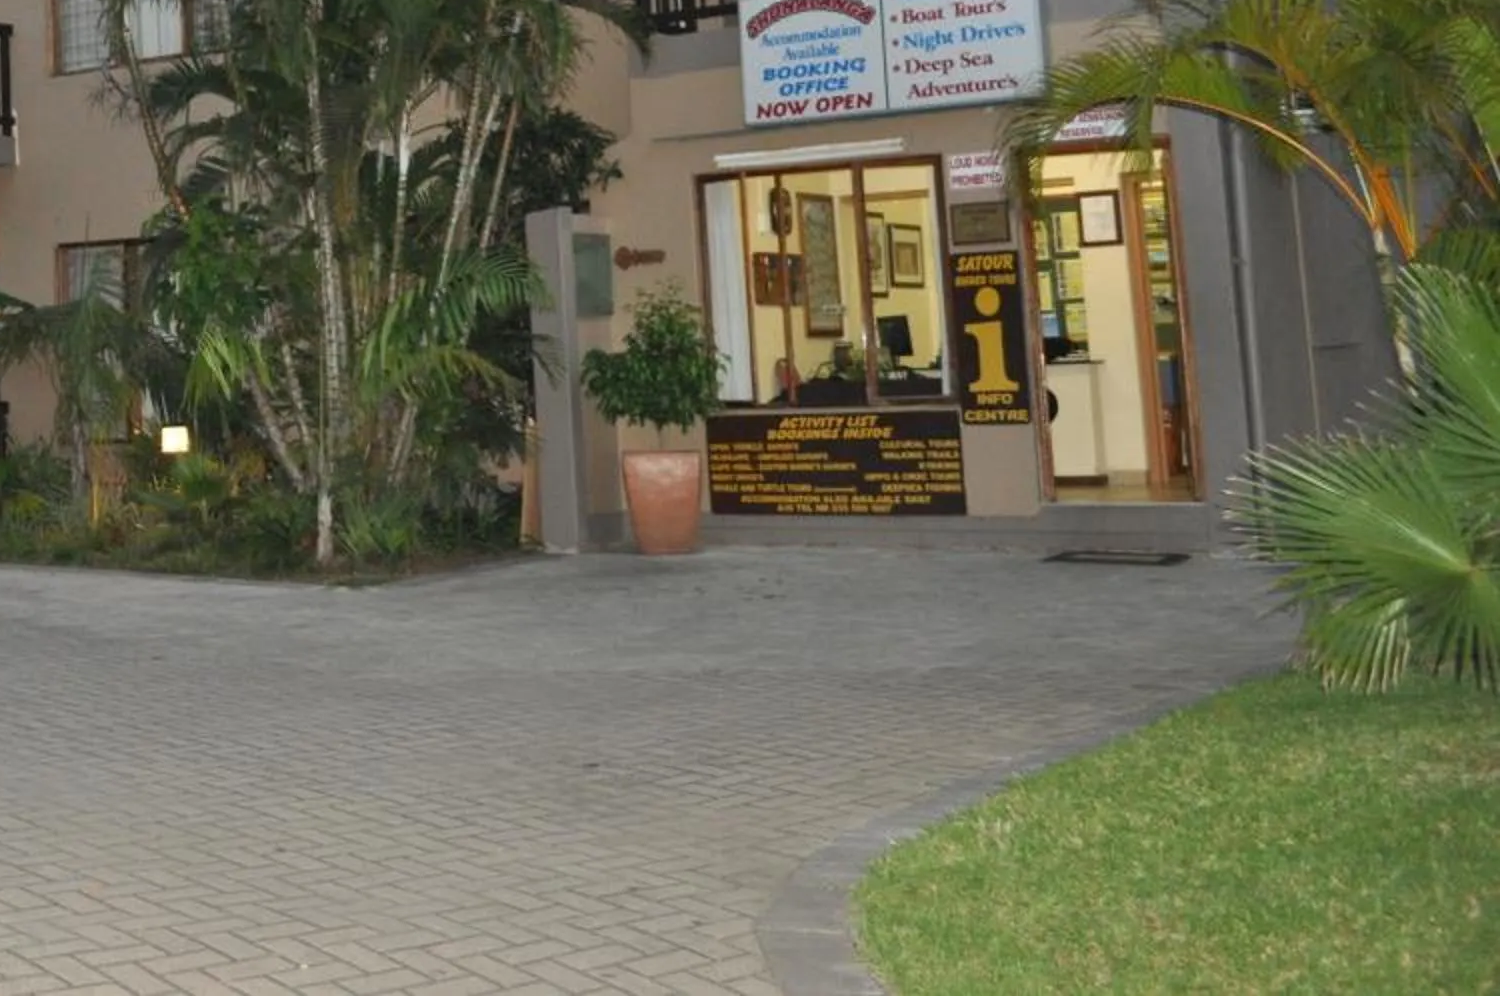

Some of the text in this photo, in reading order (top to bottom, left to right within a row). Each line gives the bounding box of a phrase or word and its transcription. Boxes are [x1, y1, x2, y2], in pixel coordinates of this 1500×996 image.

[901, 7, 945, 24] Boat
[761, 24, 862, 46] Accommodation
[903, 29, 954, 51] Night
[783, 43, 840, 61] Available
[763, 57, 866, 81] BOOKING
[904, 51, 994, 75] Deep Sea
[779, 76, 849, 97] OFFICE
[756, 92, 873, 119] NOW OPEN
[956, 253, 1014, 272] SATOUR
[977, 393, 1013, 405] INFO
[779, 414, 879, 429] ACTIVITY LIST
[963, 409, 1029, 422] CENTRE
[767, 426, 894, 441] BOOKINGS INSIDE
